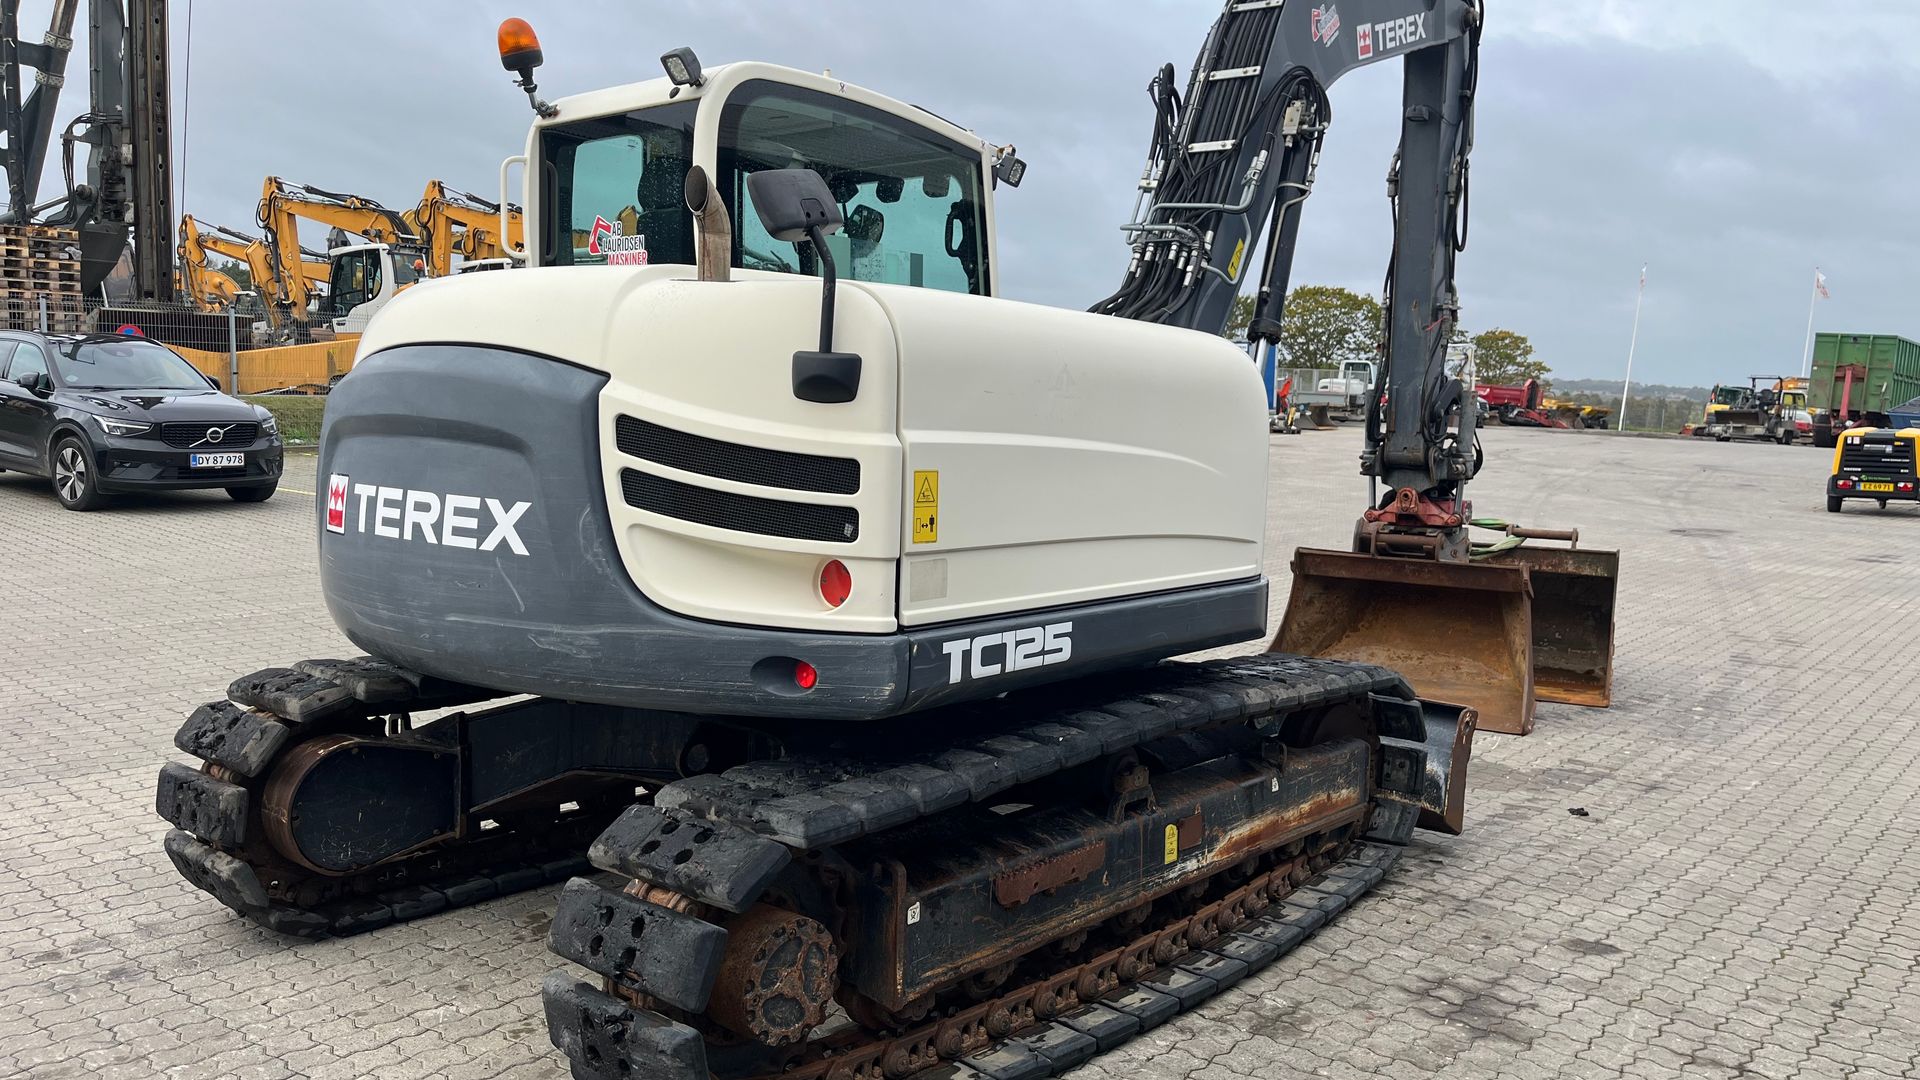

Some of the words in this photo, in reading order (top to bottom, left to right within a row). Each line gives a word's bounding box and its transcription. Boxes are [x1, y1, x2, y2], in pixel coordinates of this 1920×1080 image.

[1374, 12, 1426, 51] TEREX
[612, 222, 622, 236] AB
[603, 236, 644, 252] LAURIDSEN
[608, 252, 647, 265] MASKINER
[198, 456, 210, 465] DY
[213, 456, 224, 465] 87
[226, 455, 243, 464] 978
[353, 483, 533, 556] TEREX
[942, 621, 1073, 684] TC125
